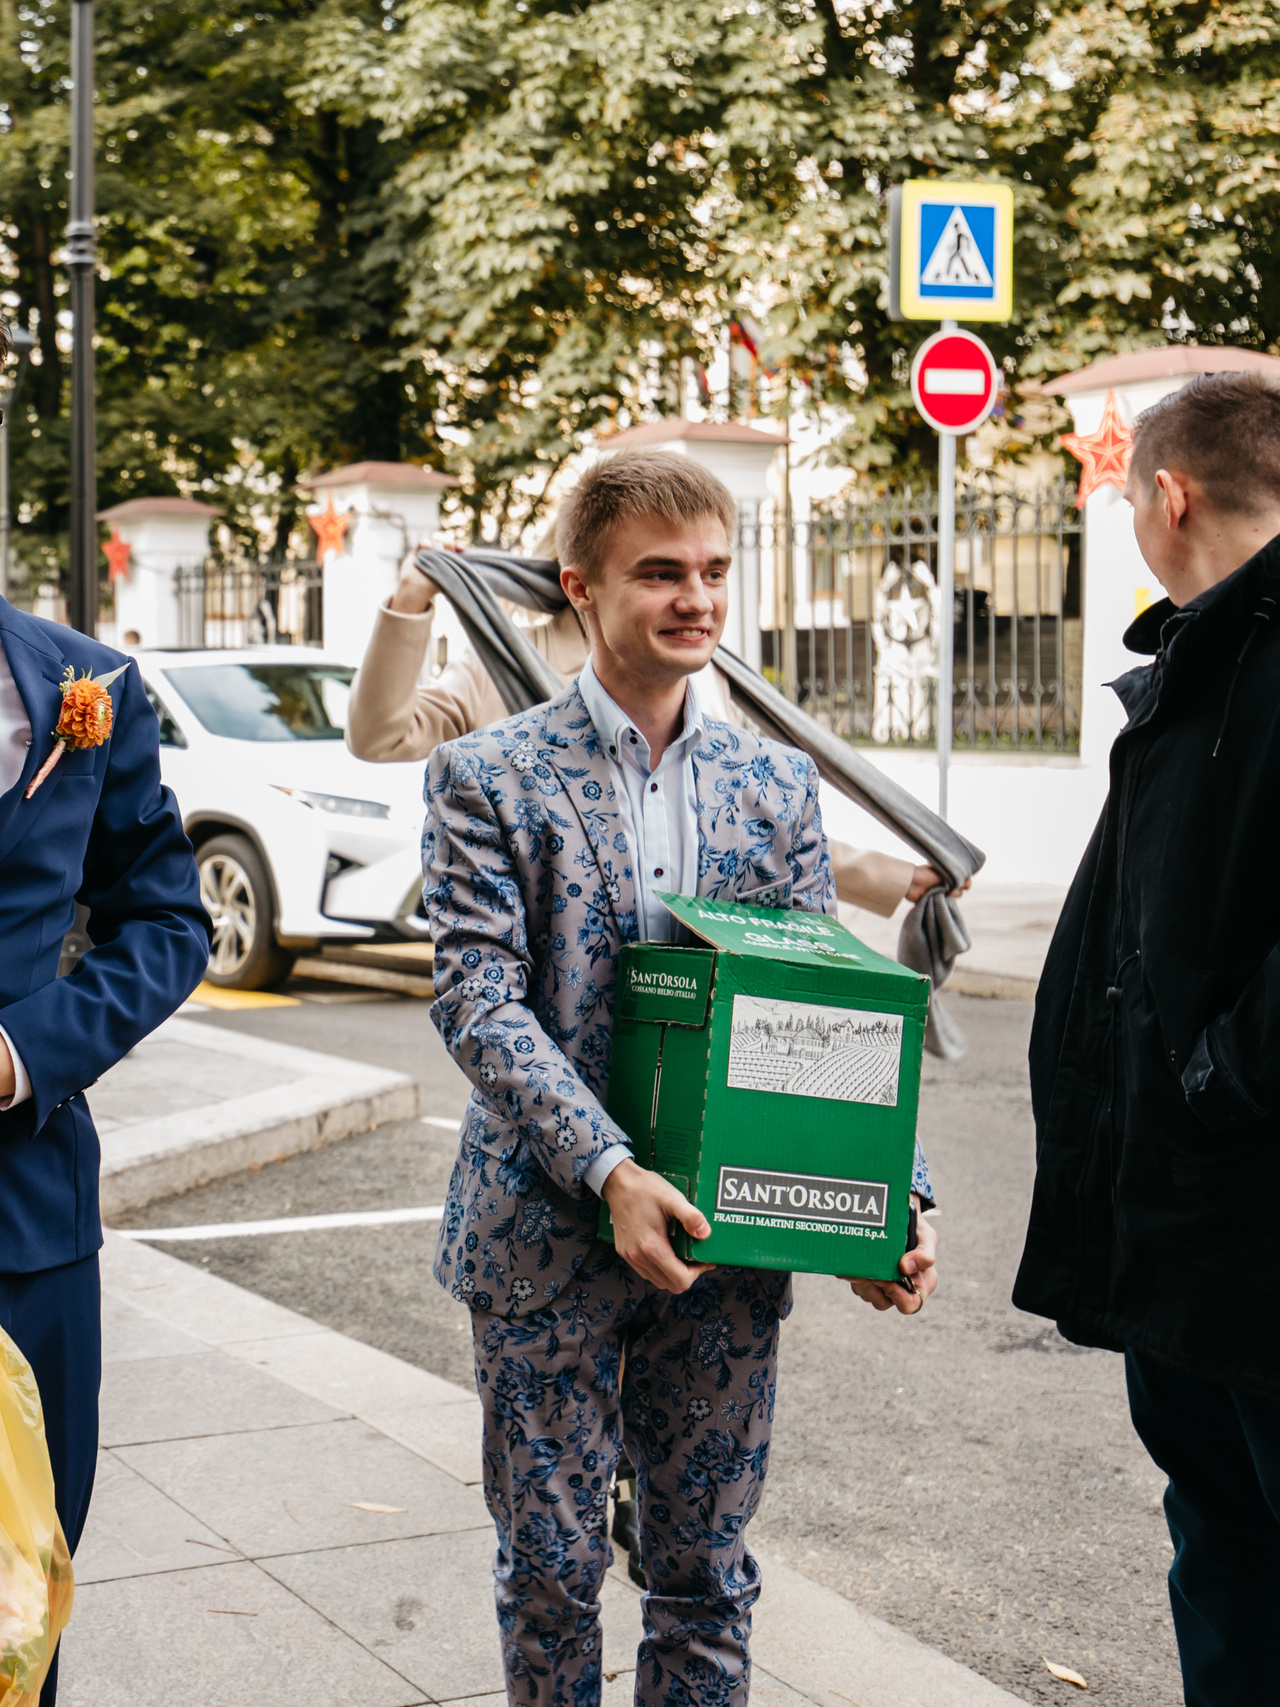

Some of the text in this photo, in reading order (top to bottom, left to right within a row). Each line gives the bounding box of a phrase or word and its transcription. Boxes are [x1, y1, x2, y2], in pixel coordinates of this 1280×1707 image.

[697, 909, 835, 937] ALTO FRAGILE
[744, 932, 836, 952] GLASS
[631, 985, 657, 994] COSSANO
[657, 987, 674, 997] BELBO
[713, 1212, 888, 1240] FRATELLI MARTINI SECONDO LUIGI S.p.A.
